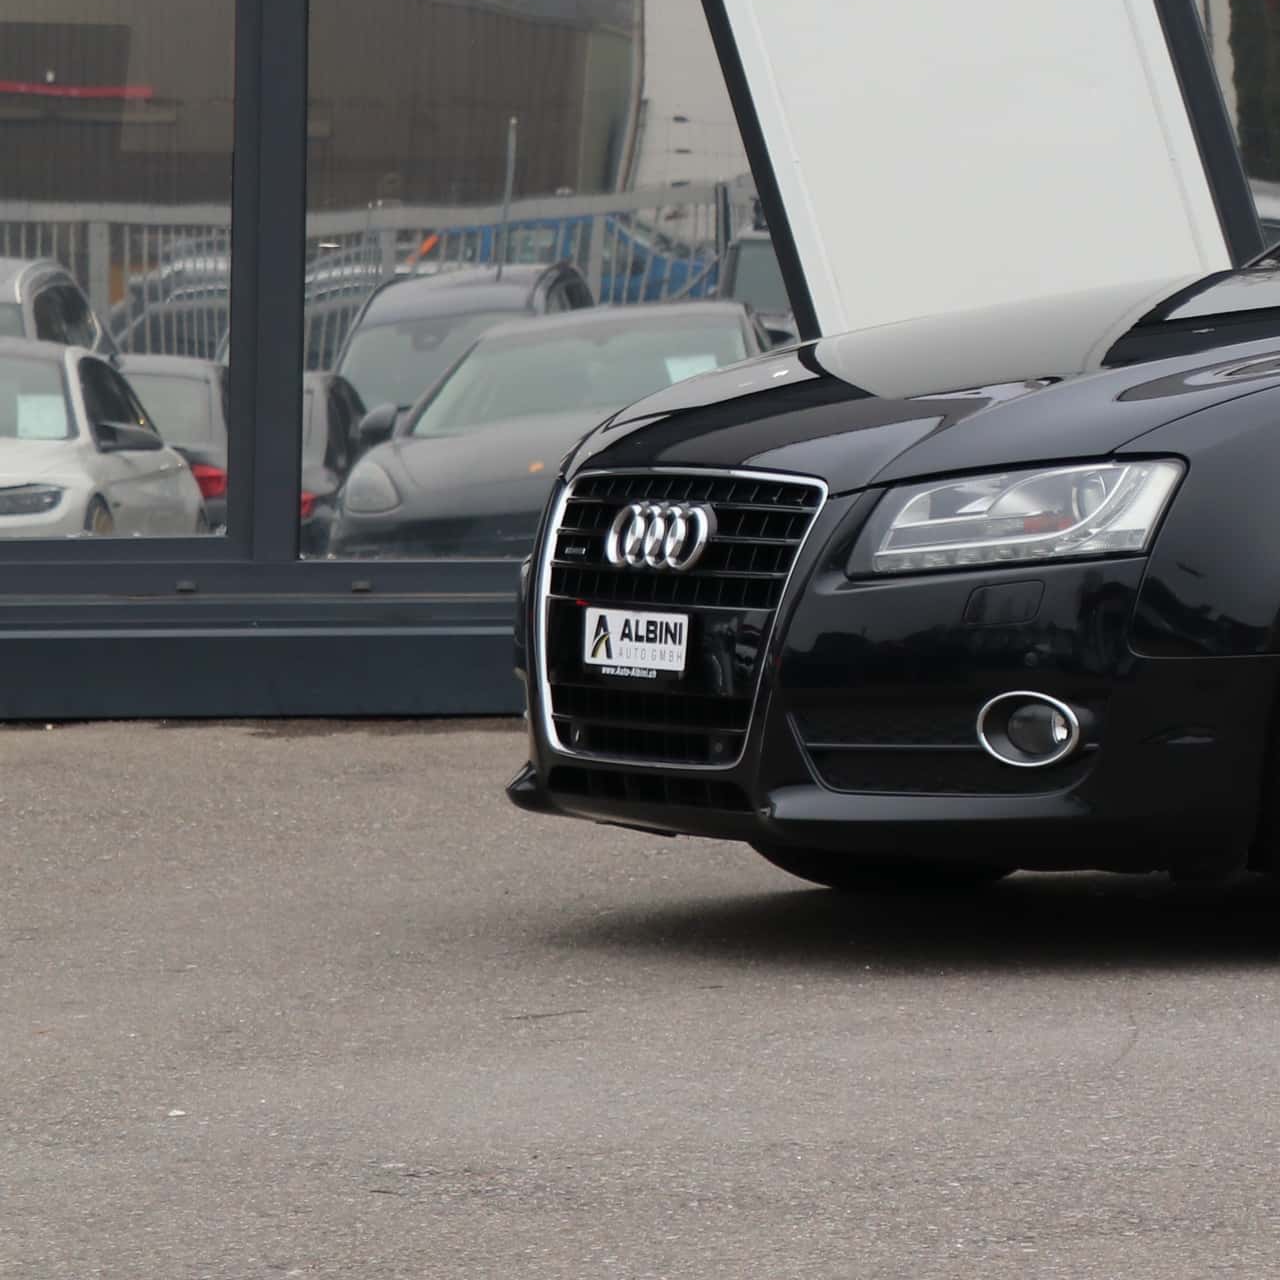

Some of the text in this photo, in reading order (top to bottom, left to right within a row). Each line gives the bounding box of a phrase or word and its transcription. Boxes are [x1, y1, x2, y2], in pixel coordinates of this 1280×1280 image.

[619, 618, 684, 646] ALBINI
[618, 645, 684, 664] AUTO GMBH
